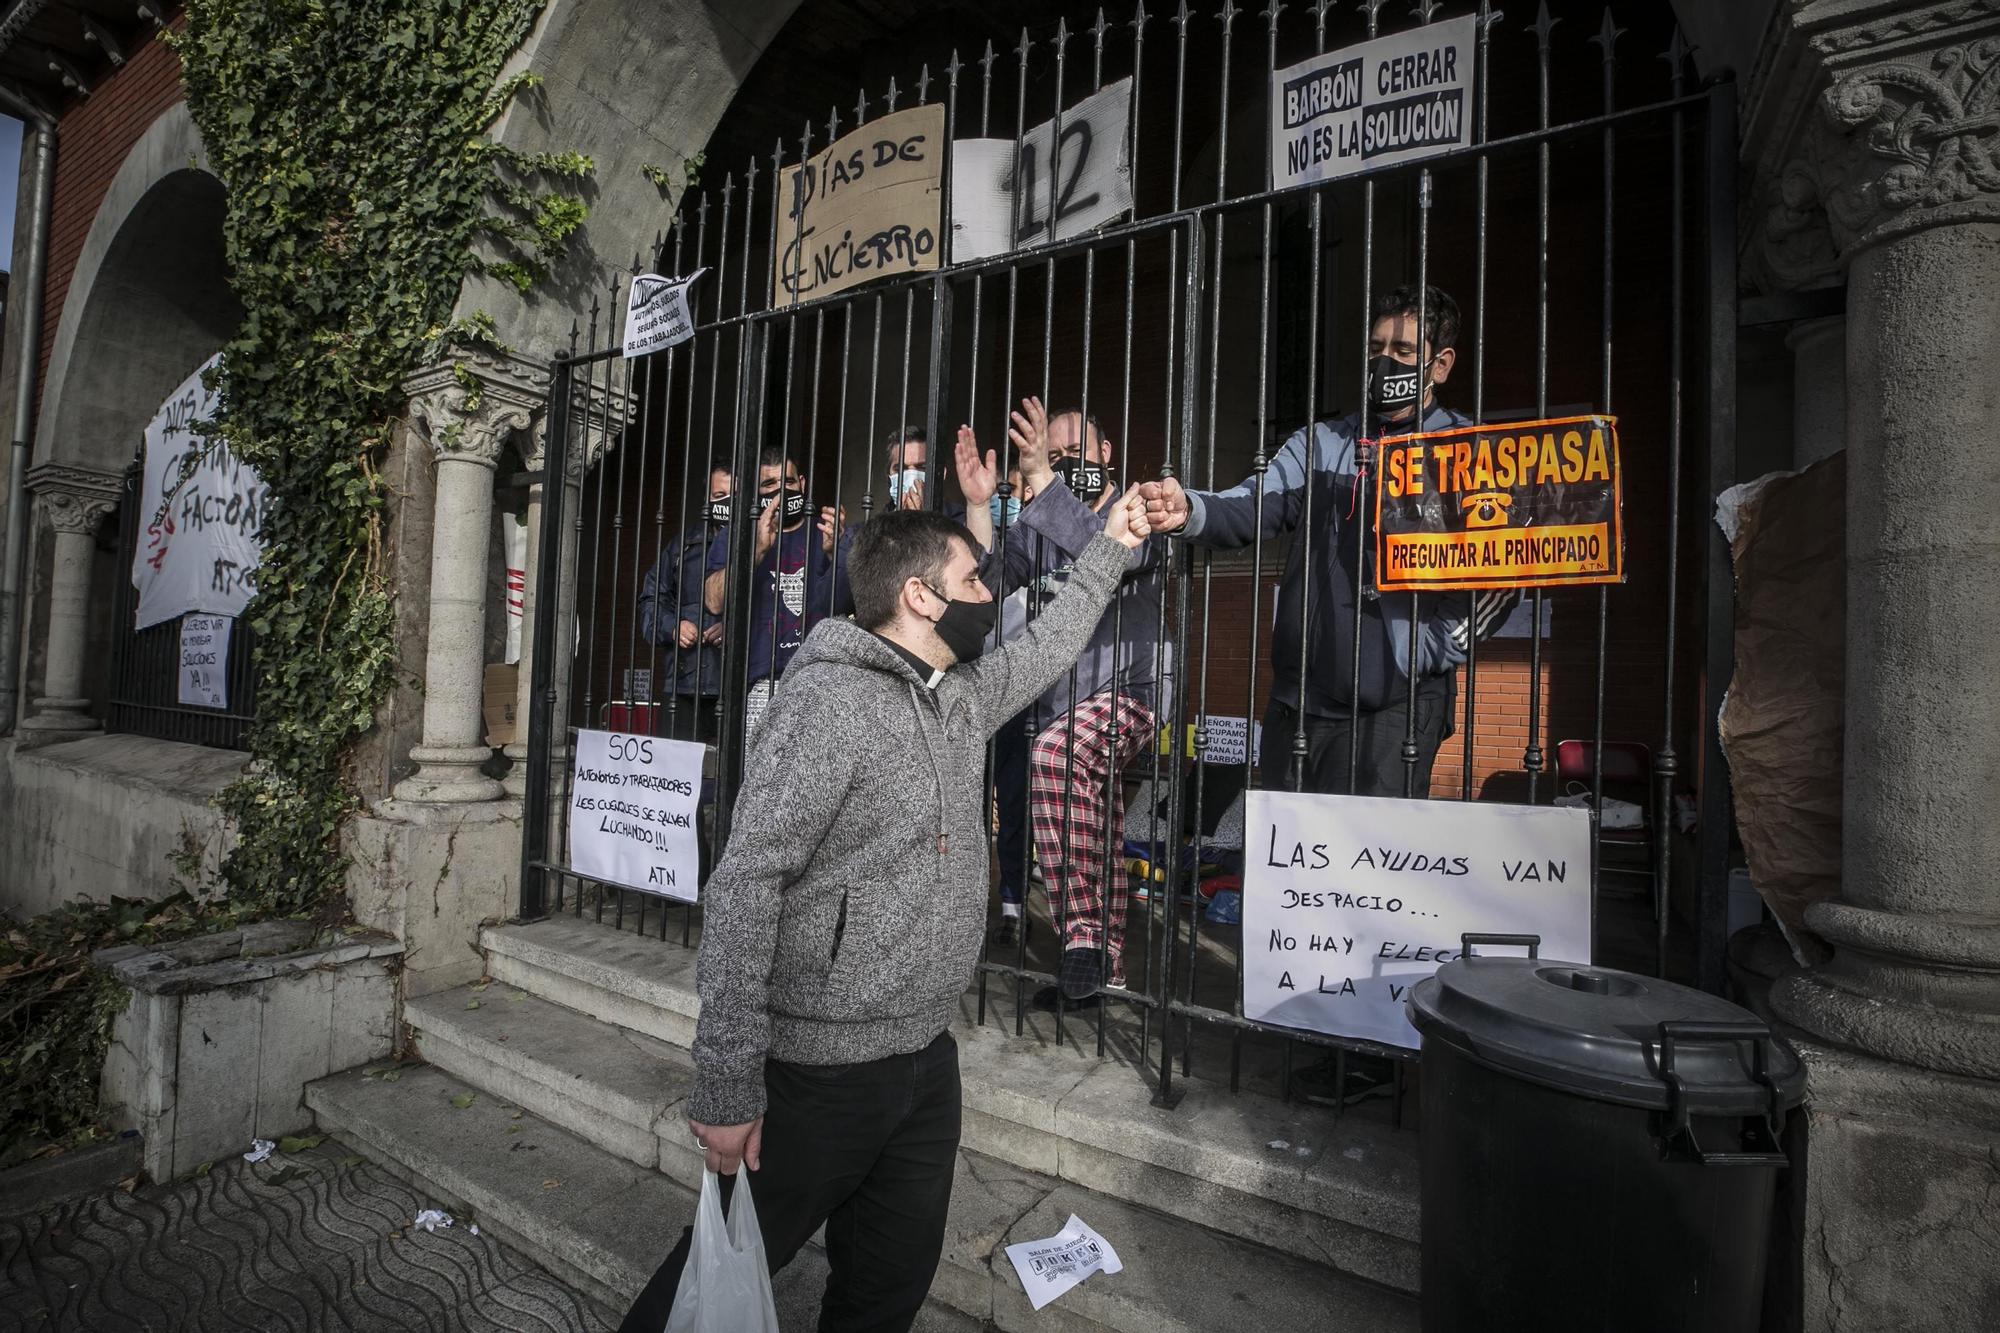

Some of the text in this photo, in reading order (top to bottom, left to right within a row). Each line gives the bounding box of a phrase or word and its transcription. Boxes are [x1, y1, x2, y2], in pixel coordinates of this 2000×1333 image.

[1287, 45, 1457, 125] BARBÓN CERRAR
[1288, 92, 1459, 176] NO ES LA SOLUCIÓN
[872, 135, 926, 168] DE
[1003, 119, 1100, 238] 12
[628, 341, 636, 350] DE
[636, 337, 648, 348] LOS
[1383, 378, 1417, 398] SOS
[1387, 429, 1610, 497] SE TRASPASA
[712, 504, 730, 515] ATN
[787, 499, 804, 512] SOS
[1392, 534, 1600, 570] PREGUNTAR AL PRINCIPADO
[1206, 718, 1233, 729] EÑOR,
[608, 734, 653, 764] SOS
[1221, 738, 1244, 746] CASA
[621, 775, 629, 787] Y
[576, 794, 596, 811] LES
[642, 807, 656, 822] SE
[1268, 824, 1567, 883] LAS AYUDAS VAN
[649, 866, 676, 886] ATN
[1269, 928, 1297, 953] NO
[1309, 933, 1354, 955] HAY
[1277, 970, 1295, 991] A
[1318, 974, 1357, 997] LA
[1033, 1241, 1102, 1273] JOKER
